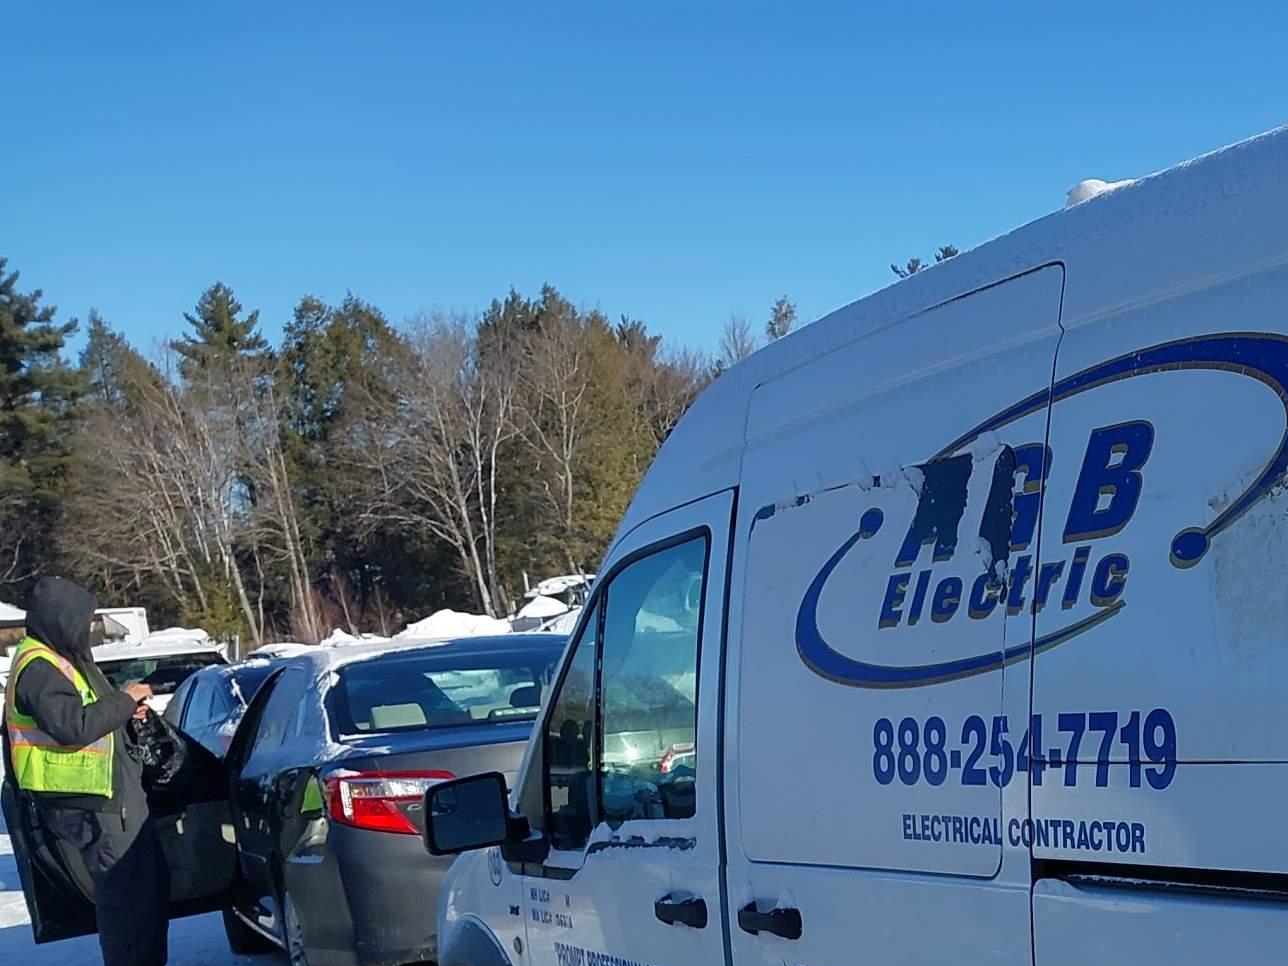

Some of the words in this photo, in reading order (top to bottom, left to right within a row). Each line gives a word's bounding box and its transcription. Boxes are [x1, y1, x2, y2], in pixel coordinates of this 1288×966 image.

[878, 547, 1130, 629] Electric
[872, 708, 1178, 791] 888-254-7719
[902, 814, 1001, 846] ELECTRICAL
[1008, 818, 1146, 854] CONTRACTOR
